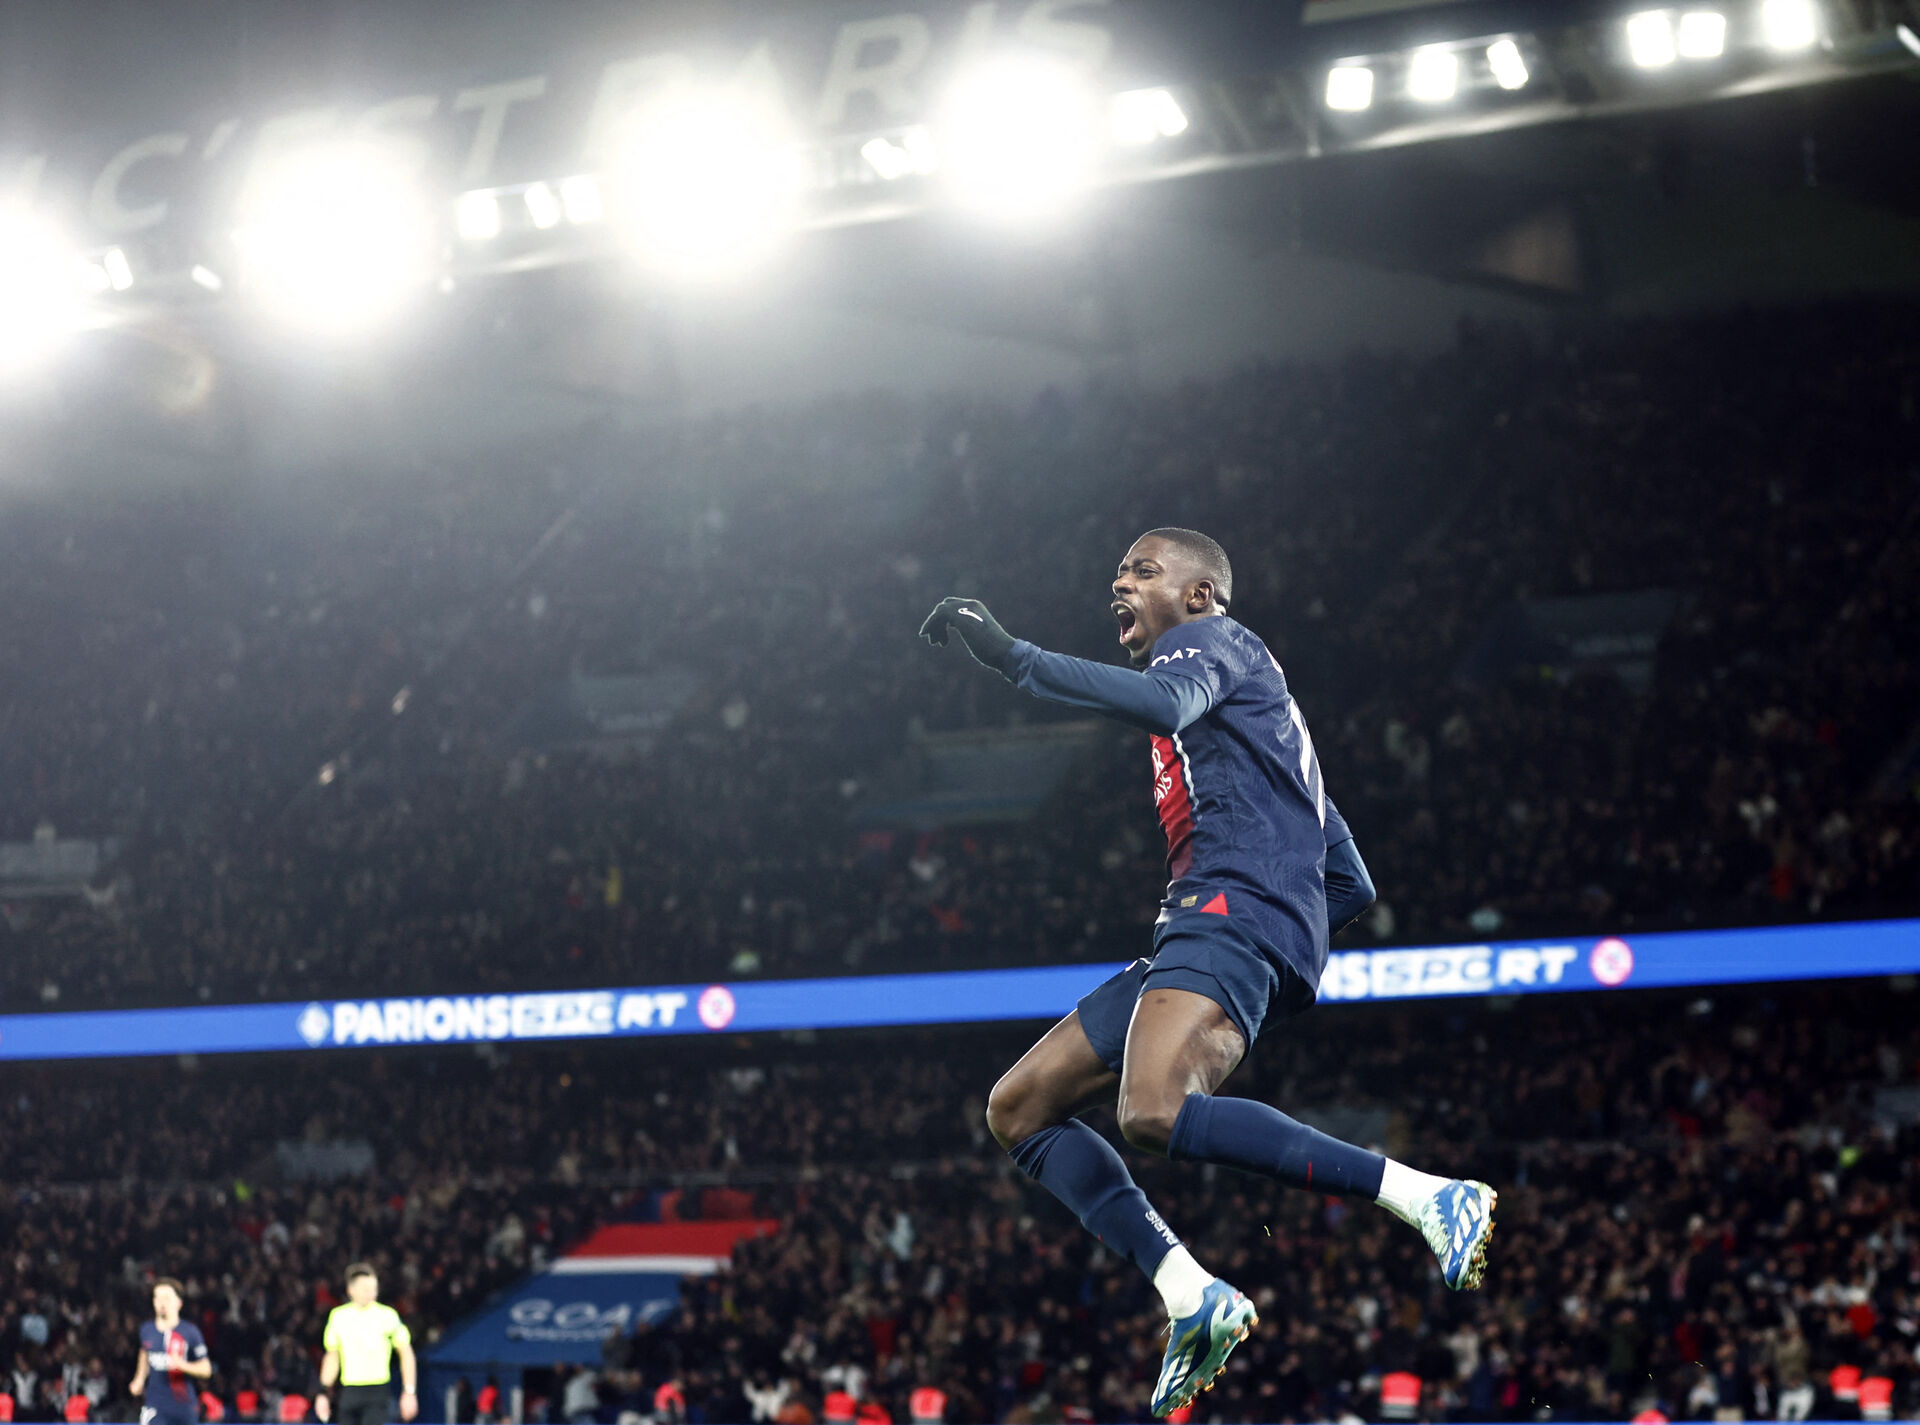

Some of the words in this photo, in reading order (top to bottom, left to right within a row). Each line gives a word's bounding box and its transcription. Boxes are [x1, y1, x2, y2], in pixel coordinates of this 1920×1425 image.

[90, 73, 548, 234] C'T
[333, 996, 509, 1045] PARIONS
[1144, 1210, 1179, 1246] PARIS
